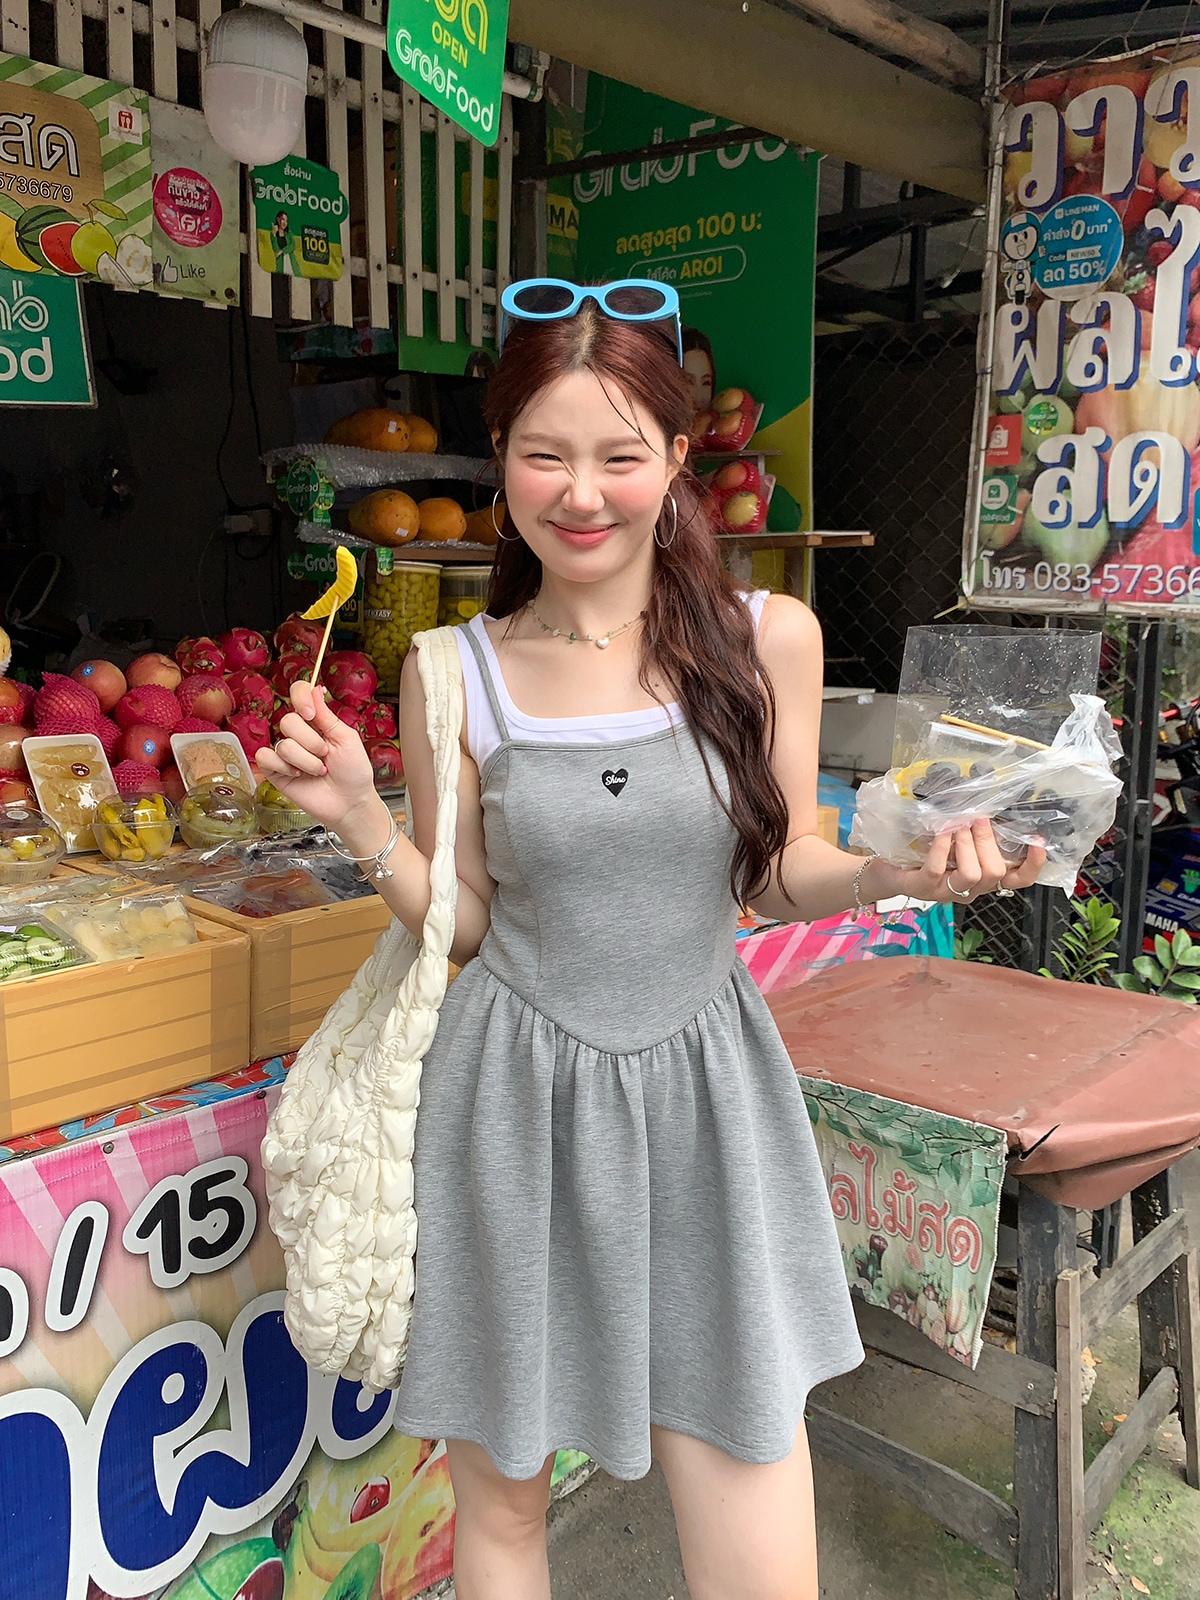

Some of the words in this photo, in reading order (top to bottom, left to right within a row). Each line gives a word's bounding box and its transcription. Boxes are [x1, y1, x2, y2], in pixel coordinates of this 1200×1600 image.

[431, 21, 469, 69] OPEN
[395, 28, 494, 132] GrabFood
[254, 177, 343, 215] GrabFood
[616, 223, 692, 256] ลดสูงสุด
[696, 211, 737, 239] 100
[1071, 219, 1086, 241] 0
[180, 263, 206, 279] Like
[679, 255, 723, 280] AROI
[1043, 267, 1066, 283] ลด
[1068, 260, 1107, 280] 50%
[992, 204, 1200, 391] ผลไ
[1031, 427, 1188, 528] สด
[980, 550, 1027, 590] โทร
[130, 1163, 251, 1281] 15
[828, 1141, 982, 1274] ลไม้สด
